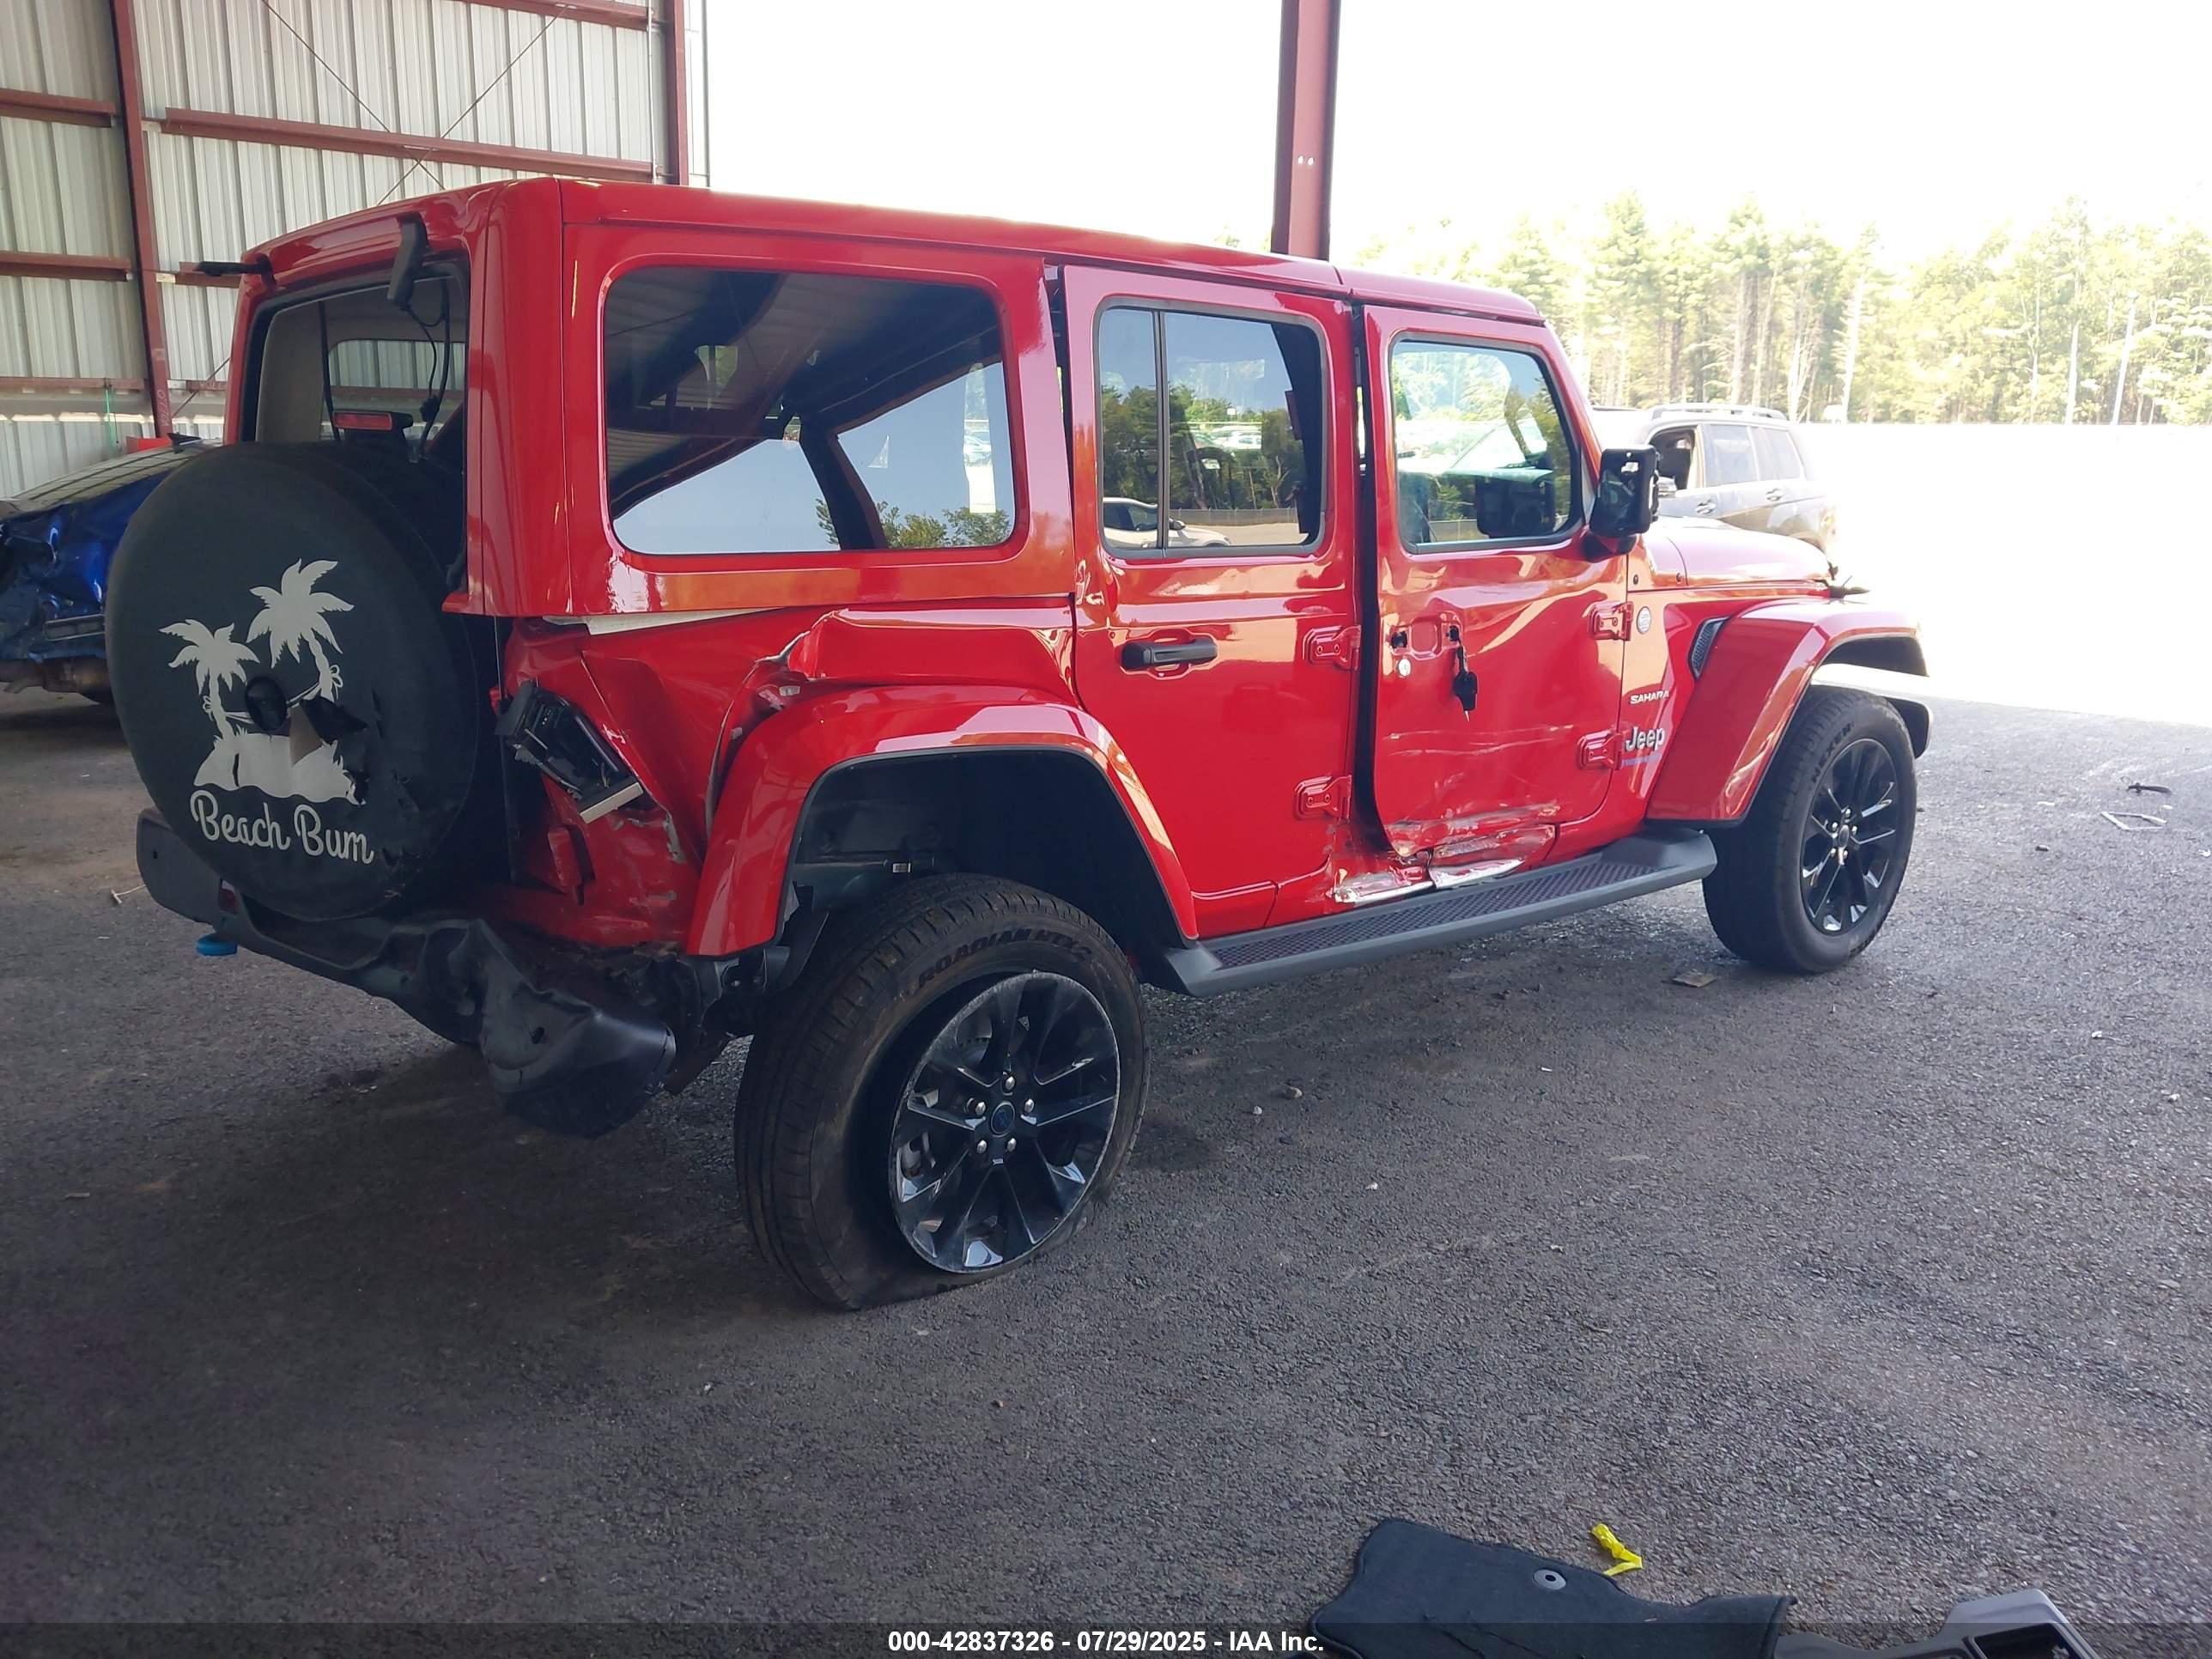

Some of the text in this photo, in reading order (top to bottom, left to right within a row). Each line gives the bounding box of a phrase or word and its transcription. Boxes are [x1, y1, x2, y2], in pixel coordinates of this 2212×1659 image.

[1630, 690, 1669, 704] SAHARA
[1625, 726, 1665, 751] Jeep
[190, 789, 374, 865] Beach Bum
[917, 928, 1031, 988] ROADIAN
